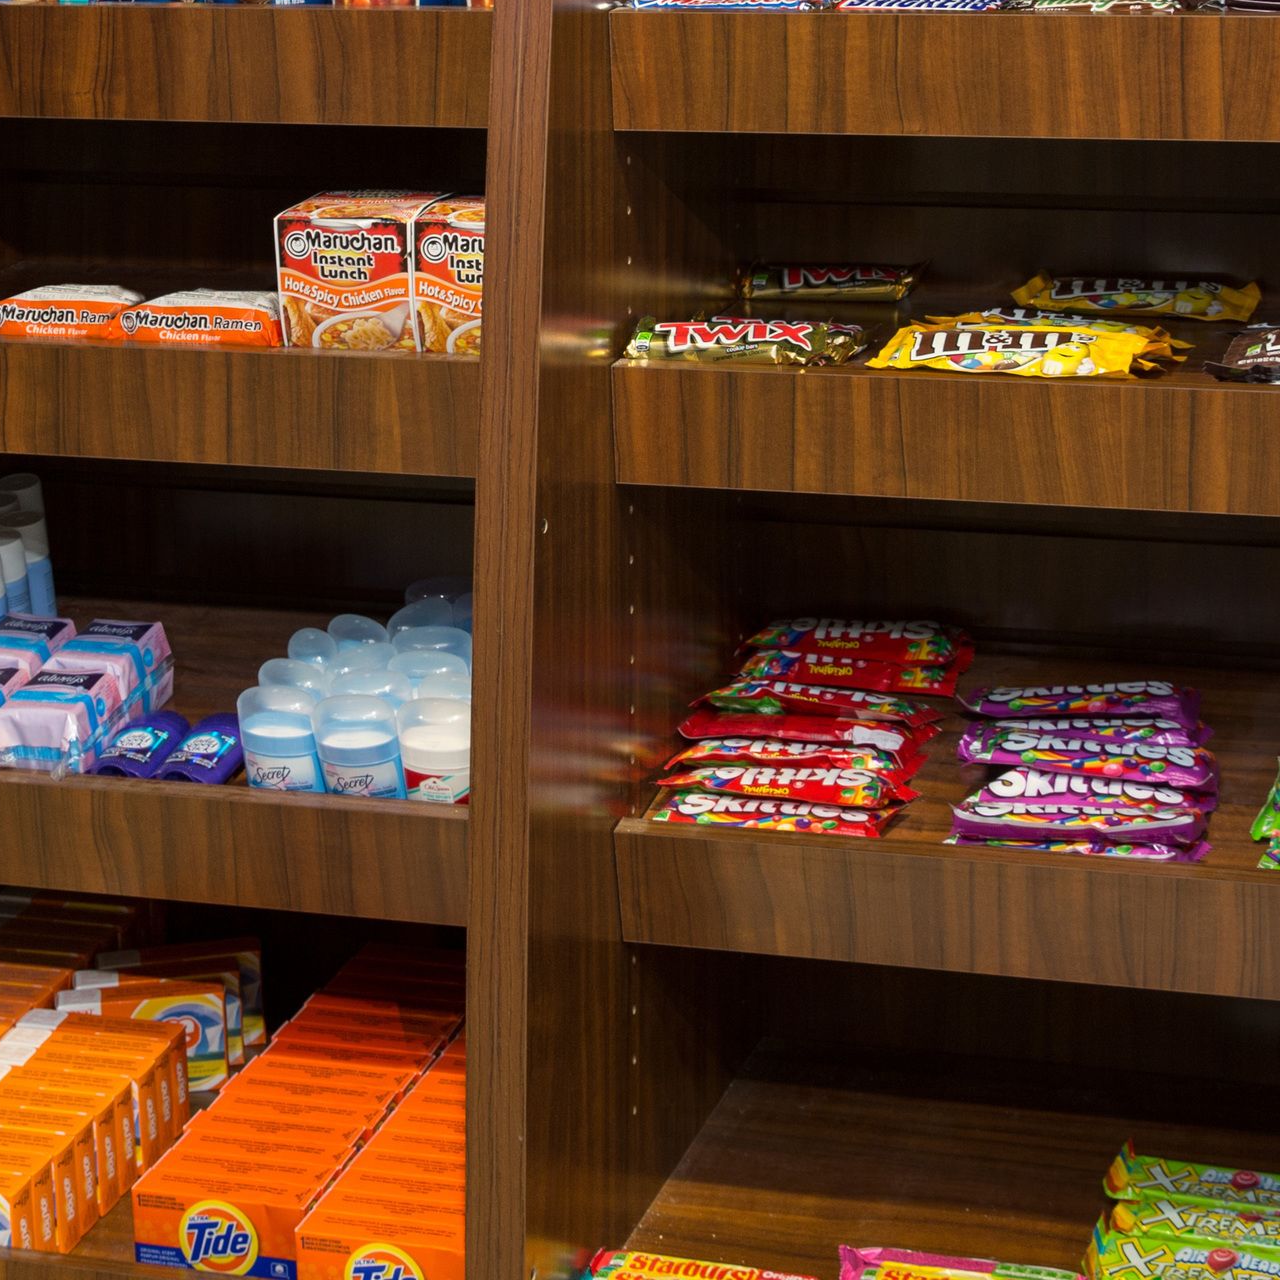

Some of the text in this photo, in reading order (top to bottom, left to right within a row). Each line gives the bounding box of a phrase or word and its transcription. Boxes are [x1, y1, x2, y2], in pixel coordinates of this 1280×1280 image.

[306, 230, 398, 255] Maruchan
[313, 252, 374, 269] Instant
[320, 265, 369, 282] Lunch
[1, 305, 76, 330] Maruchan
[135, 311, 261, 332] Maruchan Ramen
[655, 321, 812, 351] TWIX
[256, 766, 290, 783] Secret
[337, 774, 374, 790] Secret
[697, 767, 875, 787] Skittles
[677, 793, 870, 823] Skittles
[186, 1220, 251, 1263] Tide
